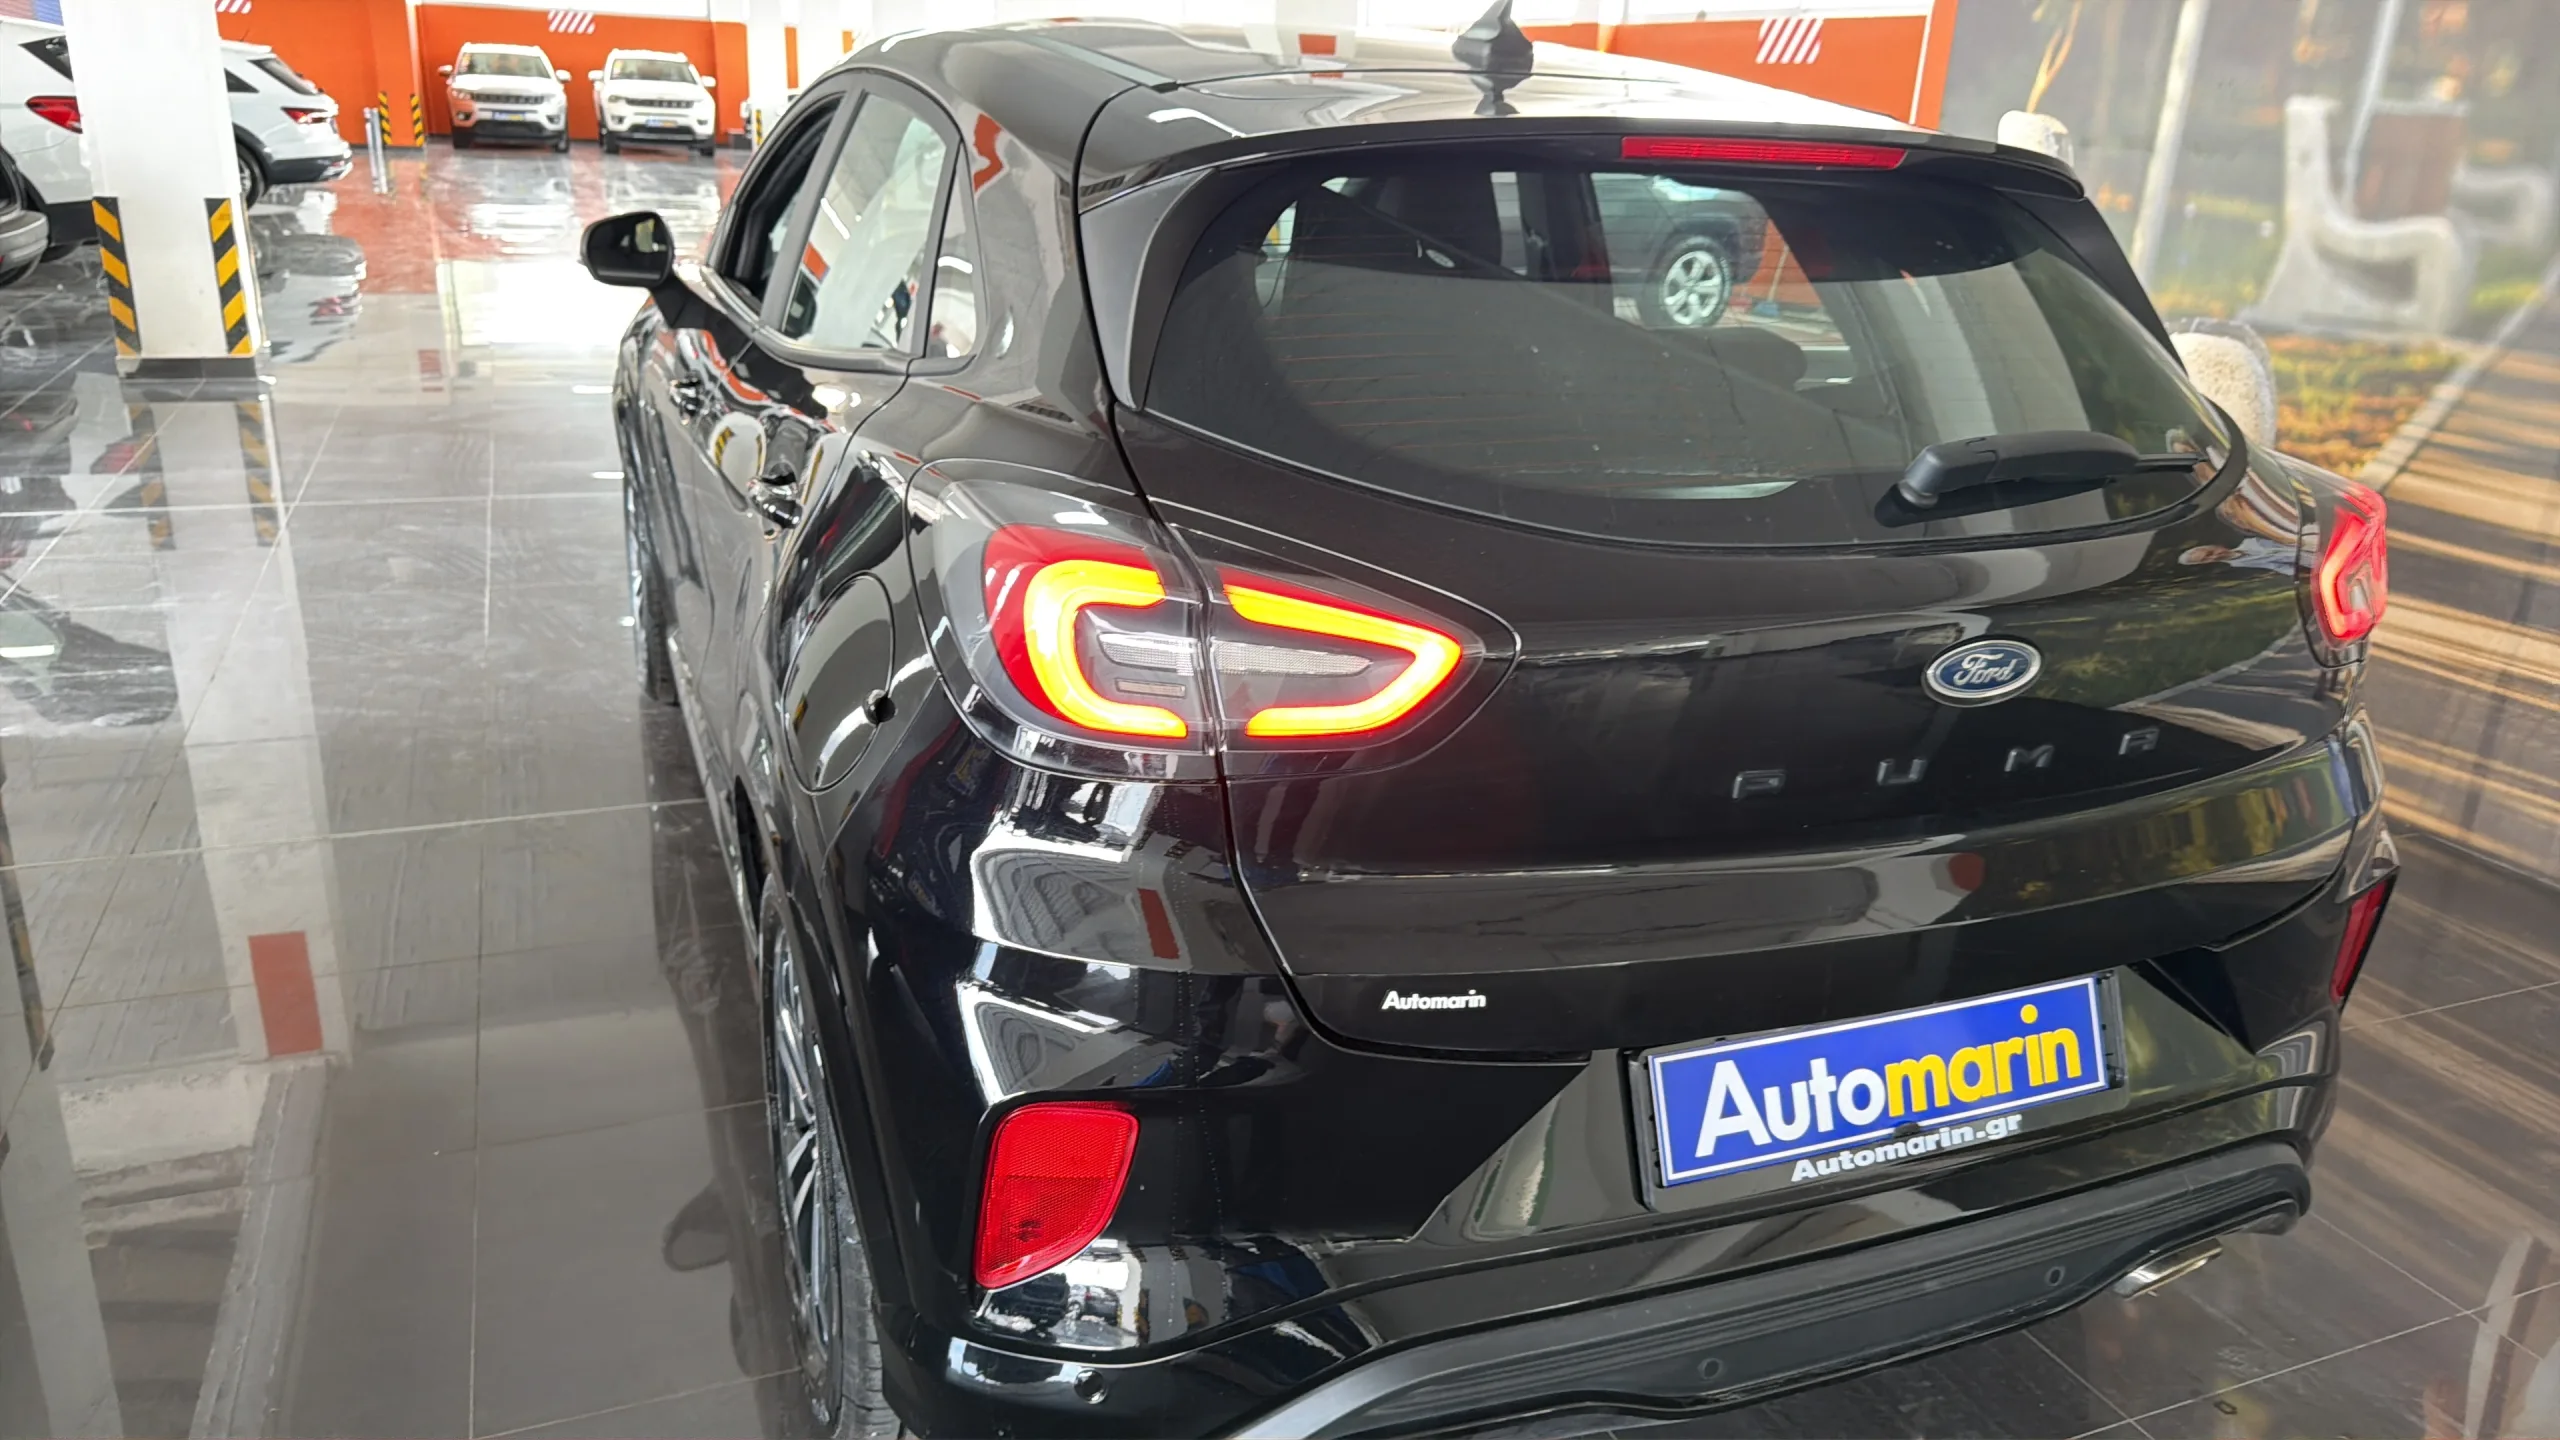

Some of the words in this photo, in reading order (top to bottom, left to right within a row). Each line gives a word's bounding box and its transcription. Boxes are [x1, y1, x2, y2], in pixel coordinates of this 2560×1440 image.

[1953, 653, 2020, 686] Ford
[1732, 727, 2159, 799] PUMA
[1381, 989, 1487, 1010] Automarin
[1695, 1004, 2082, 1158] Automarin
[1791, 1114, 2023, 1182] Automarin.gr
